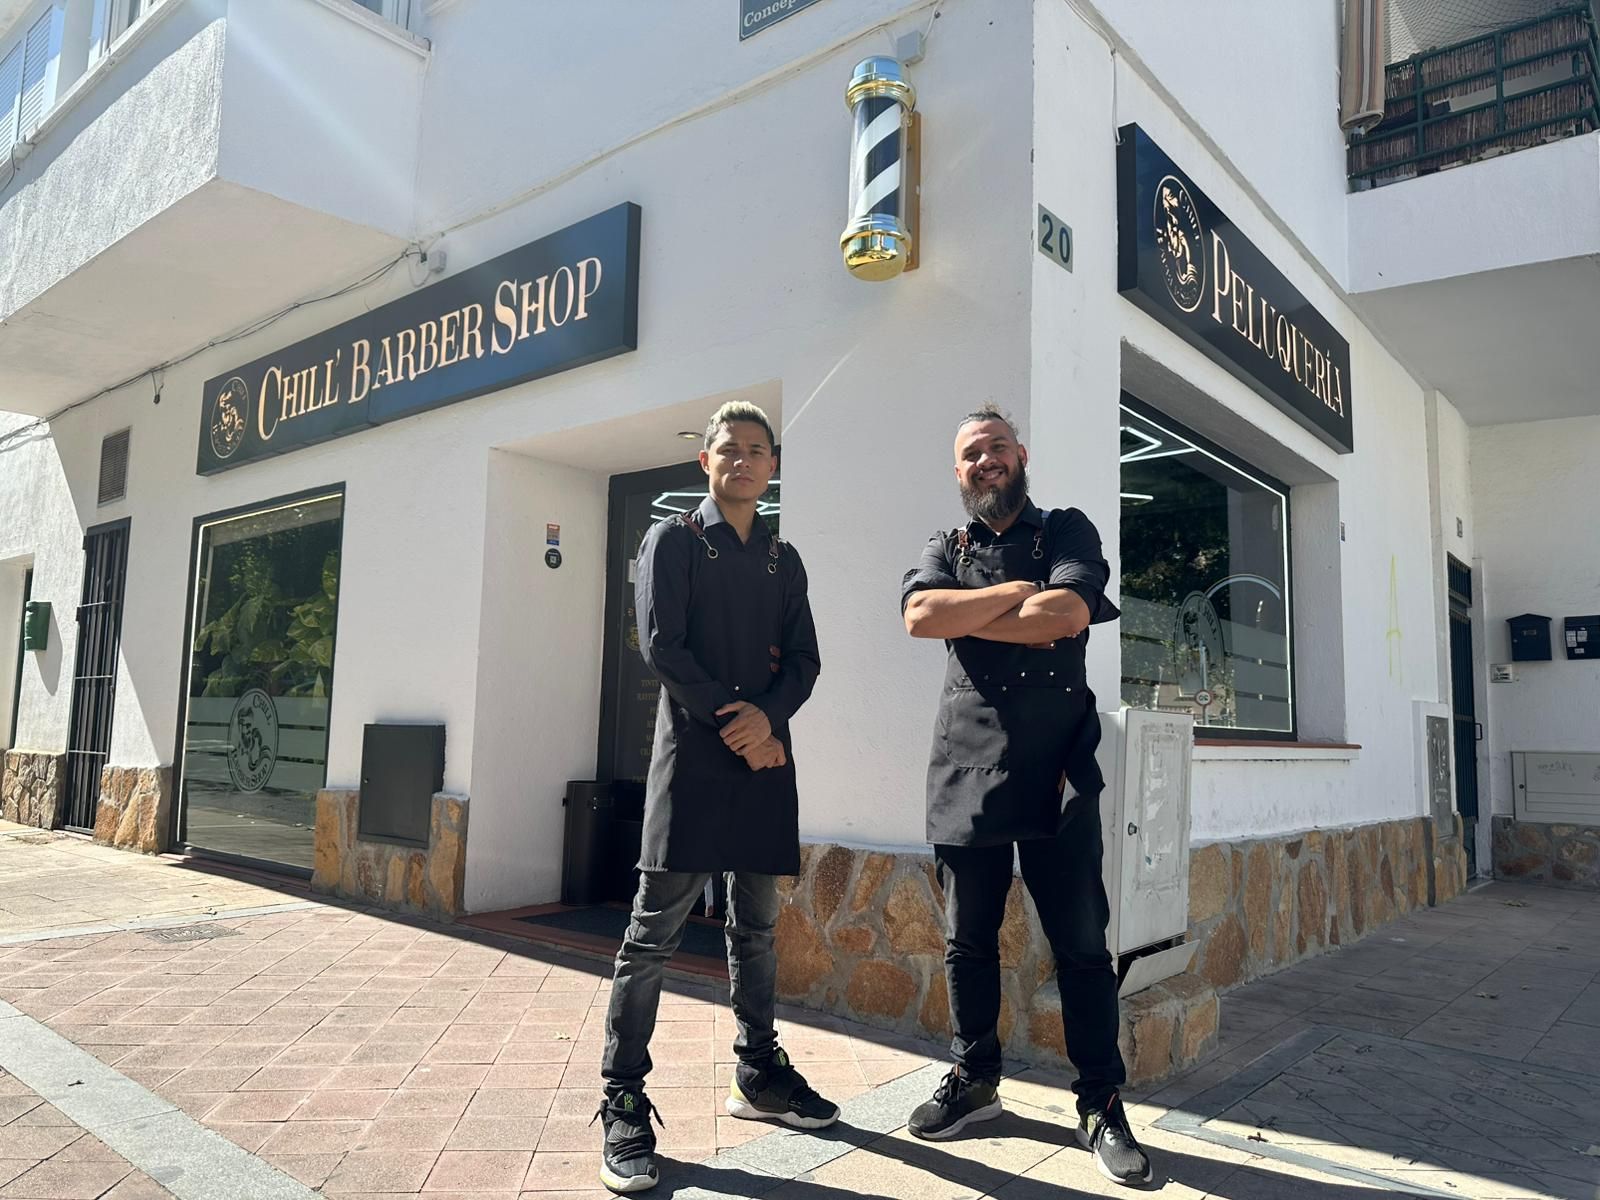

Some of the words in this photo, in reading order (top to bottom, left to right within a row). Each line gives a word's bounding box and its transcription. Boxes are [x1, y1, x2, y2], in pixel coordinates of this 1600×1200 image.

[1042, 213, 1071, 264] 20
[1210, 228, 1345, 419] PELUQUERÍA
[258, 348, 340, 440] CHILL'
[348, 303, 484, 404] BARBER
[491, 257, 602, 355] SHOP
